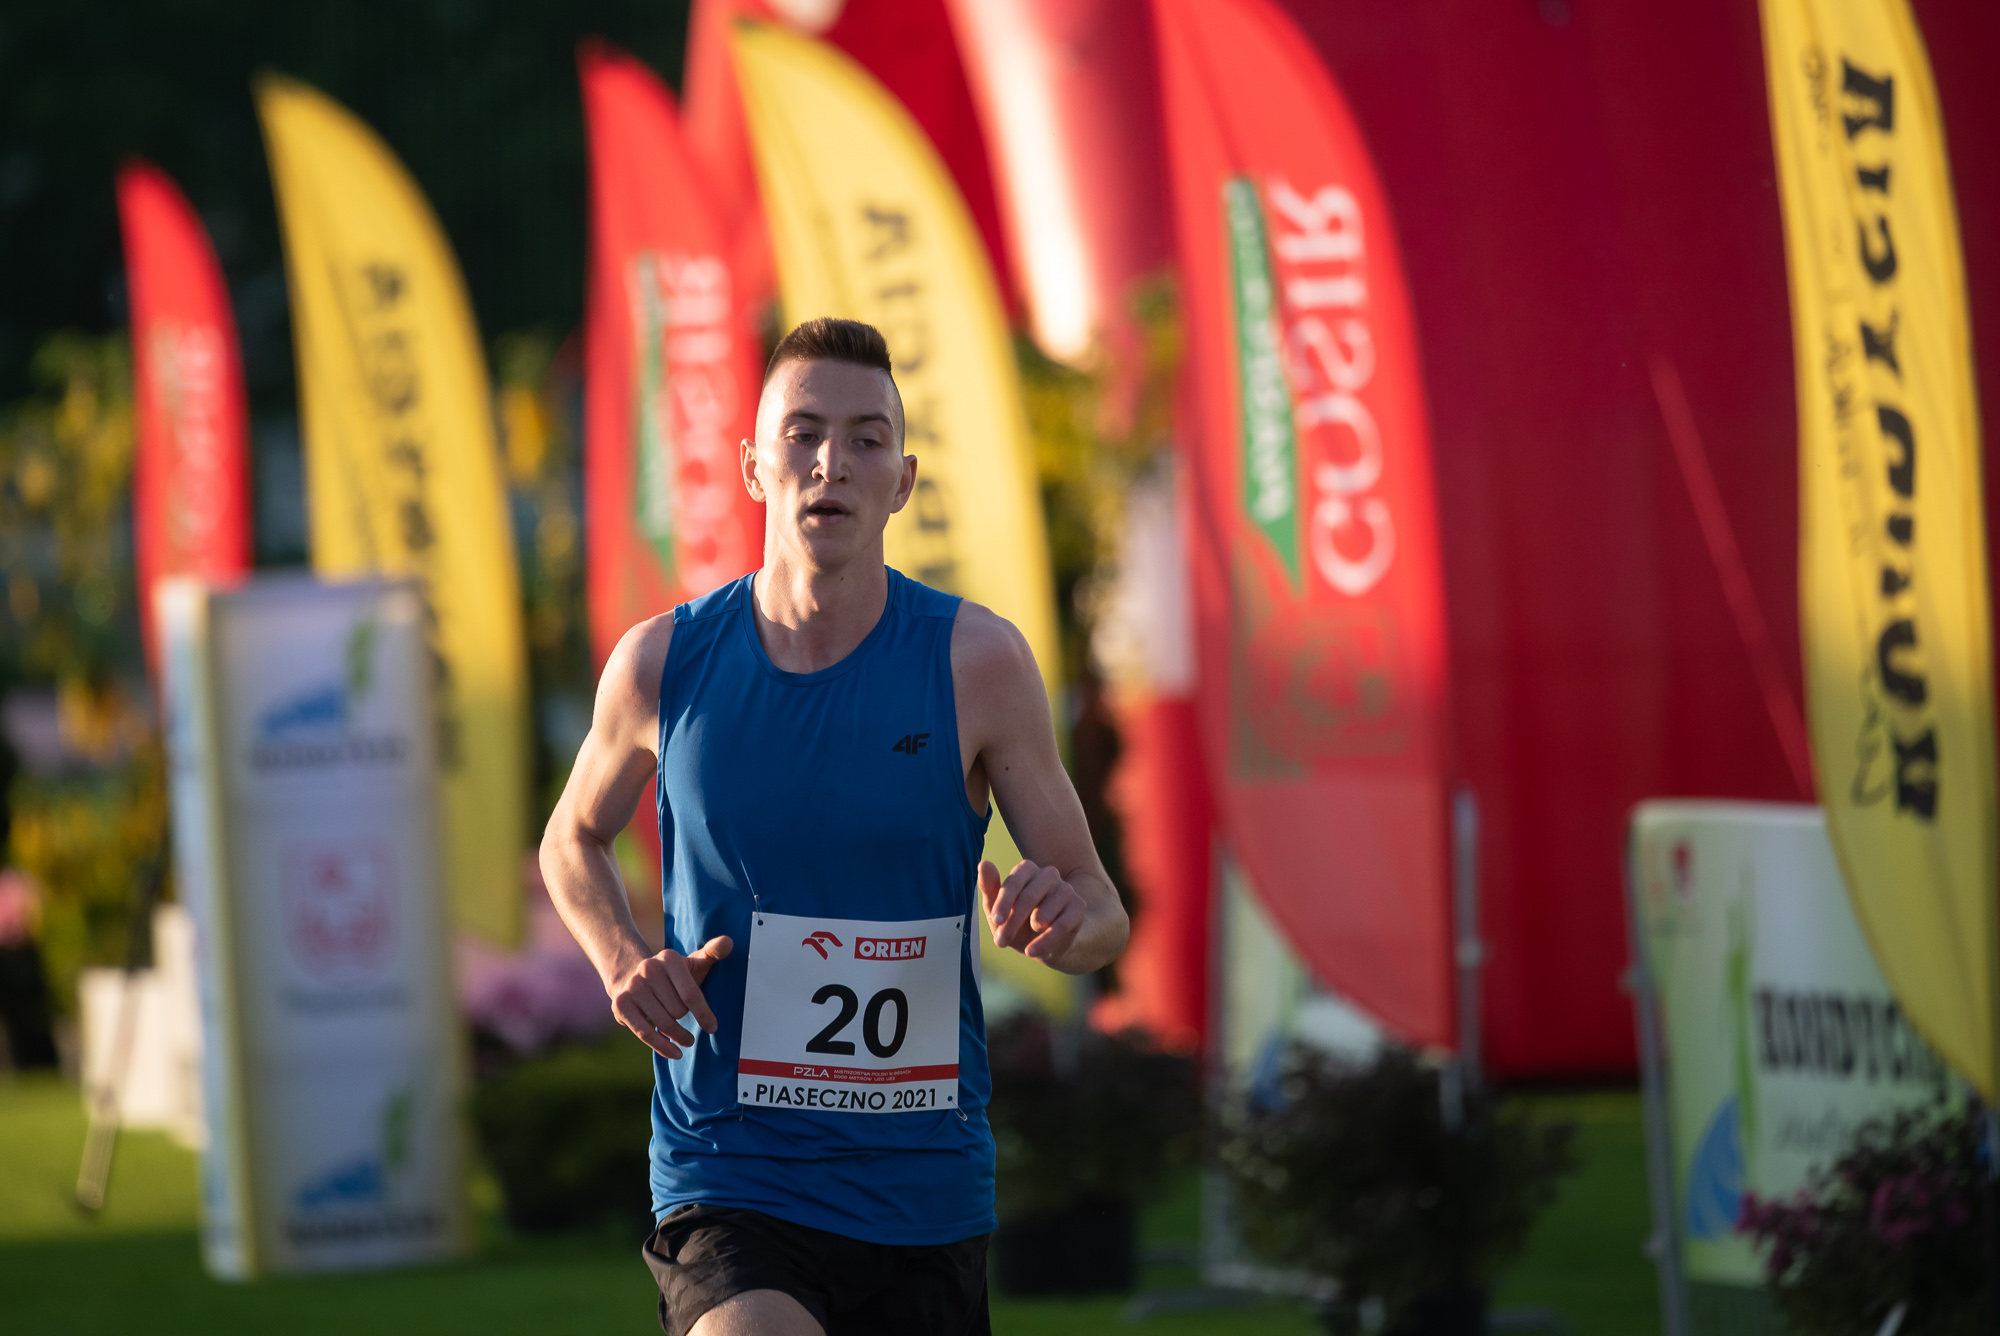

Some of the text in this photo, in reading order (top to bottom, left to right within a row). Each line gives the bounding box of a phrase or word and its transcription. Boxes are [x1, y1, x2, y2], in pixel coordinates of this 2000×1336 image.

[892, 733, 931, 755] 4F
[859, 941, 923, 958] ORLEN
[805, 984, 909, 1059] 20
[793, 1066, 830, 1078] PZLA
[755, 1083, 936, 1111] PIASECZNO 2021
